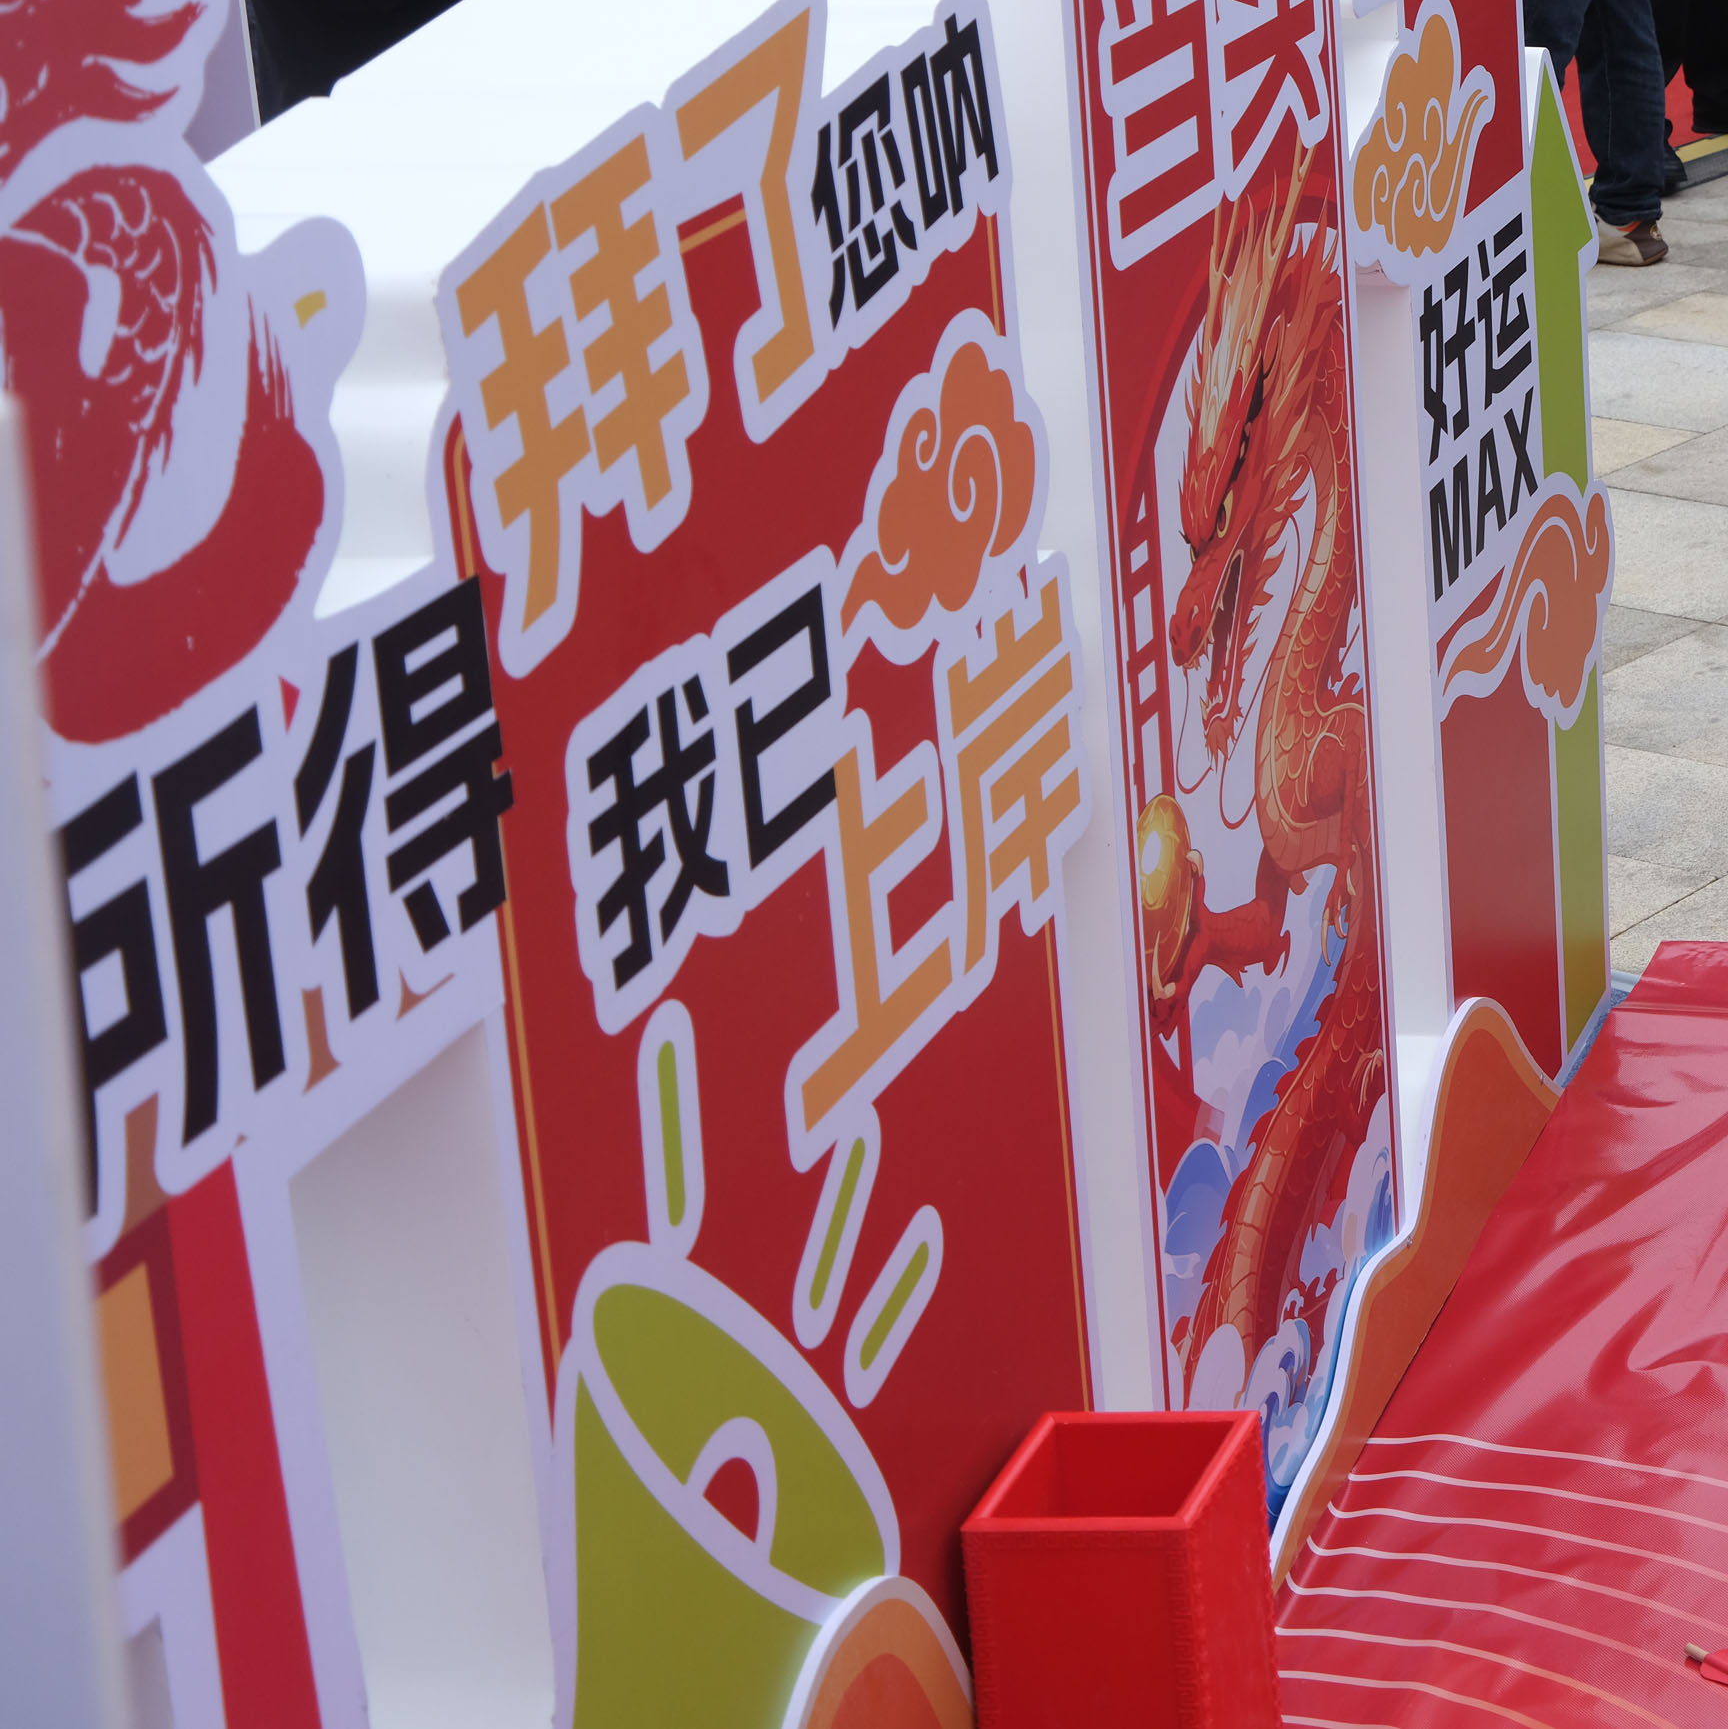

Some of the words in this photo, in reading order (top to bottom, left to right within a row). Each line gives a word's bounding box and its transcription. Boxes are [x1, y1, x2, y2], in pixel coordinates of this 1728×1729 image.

[1420, 212, 1533, 462] 好运
[1430, 388, 1539, 602] MAX
[56, 574, 514, 1215] 所得
